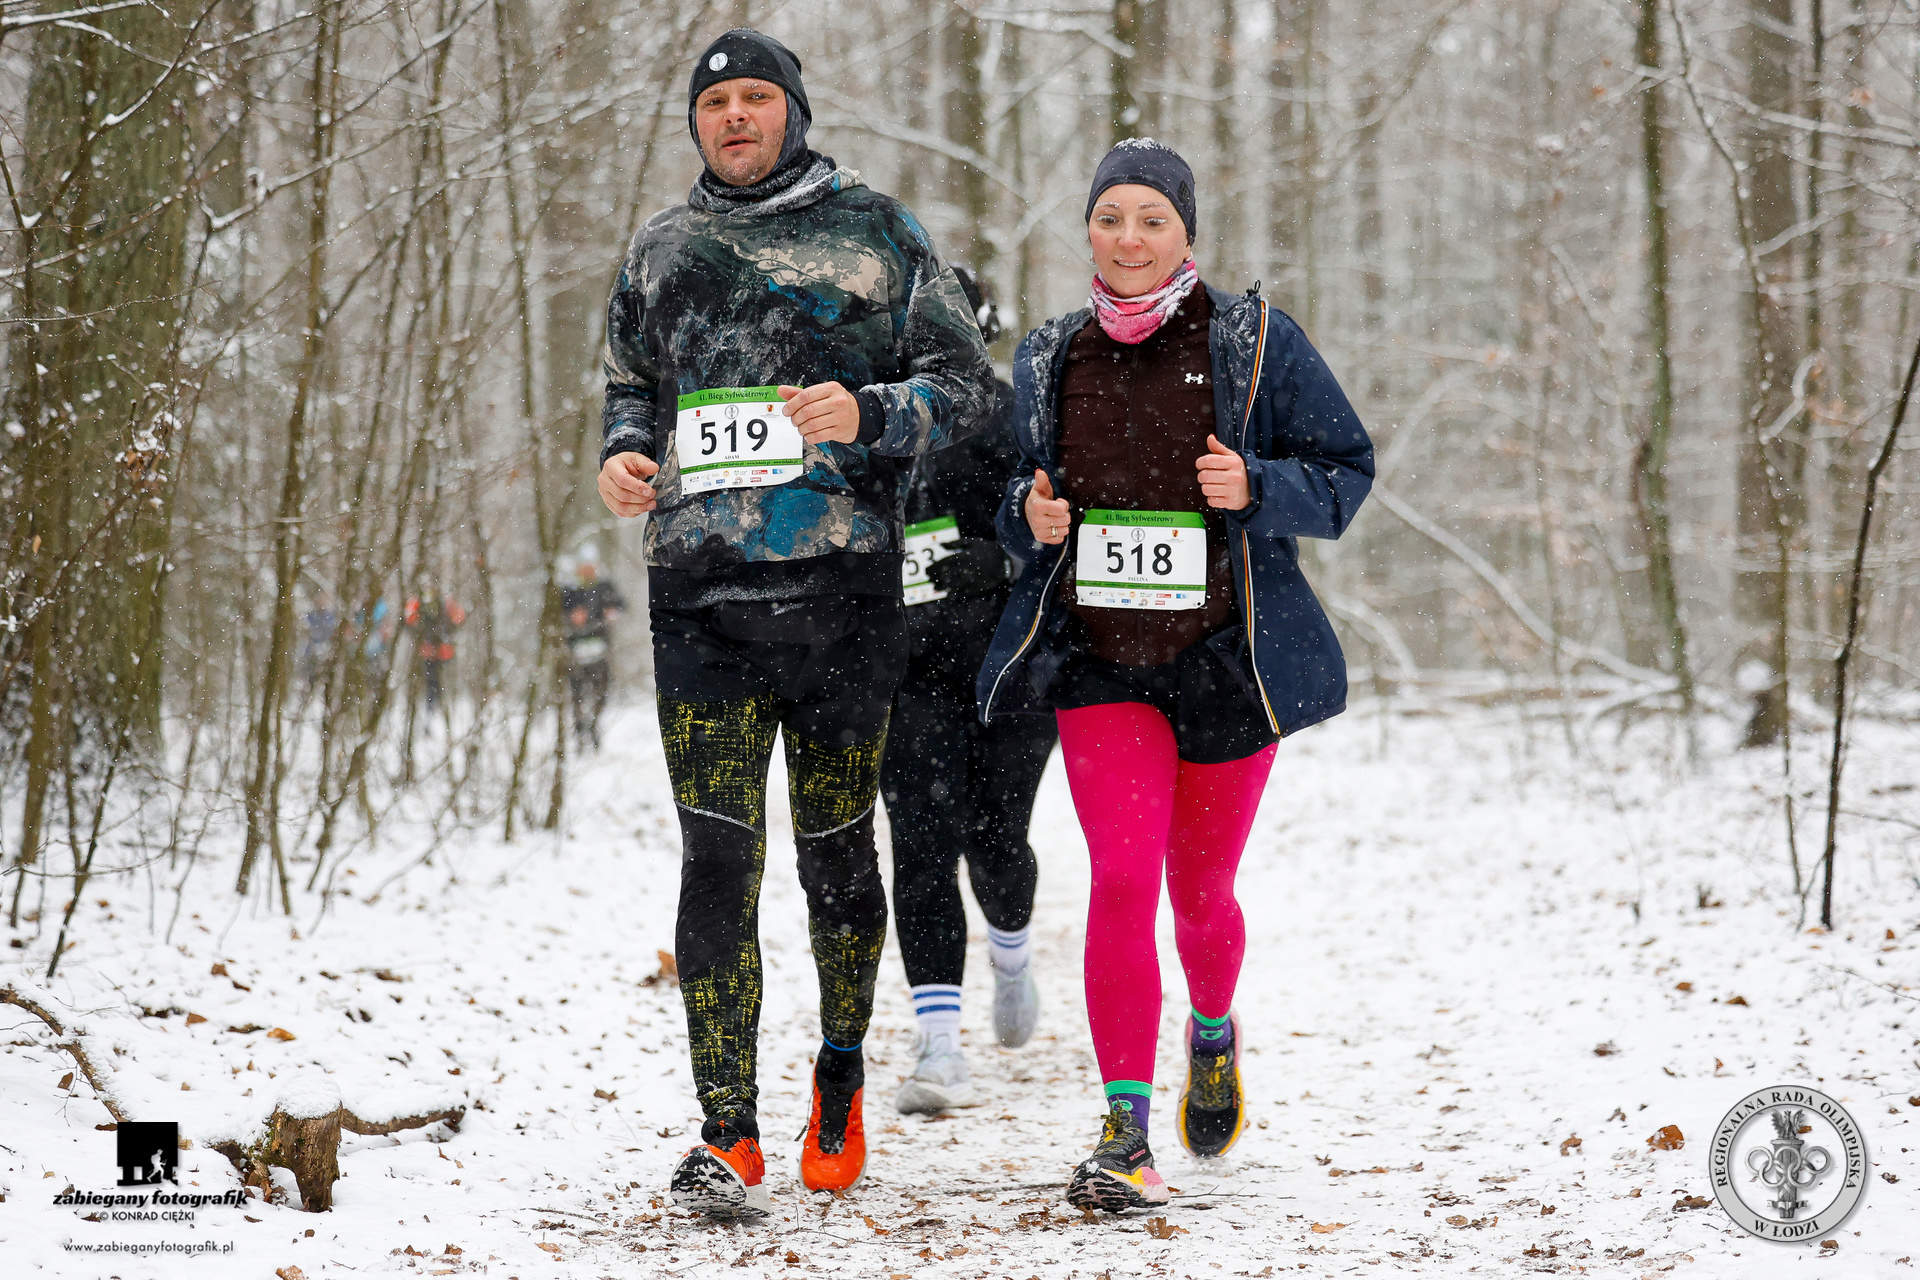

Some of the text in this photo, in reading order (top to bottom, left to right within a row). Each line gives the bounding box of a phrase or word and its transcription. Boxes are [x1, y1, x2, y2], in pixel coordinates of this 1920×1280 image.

[708, 391, 724, 401] Bieg
[724, 390, 769, 400] Sylwestrowy
[701, 418, 768, 455] 519
[1116, 514, 1131, 523] Bieg
[1131, 514, 1174, 524] Sylwestrowy
[1107, 542, 1173, 576] 518
